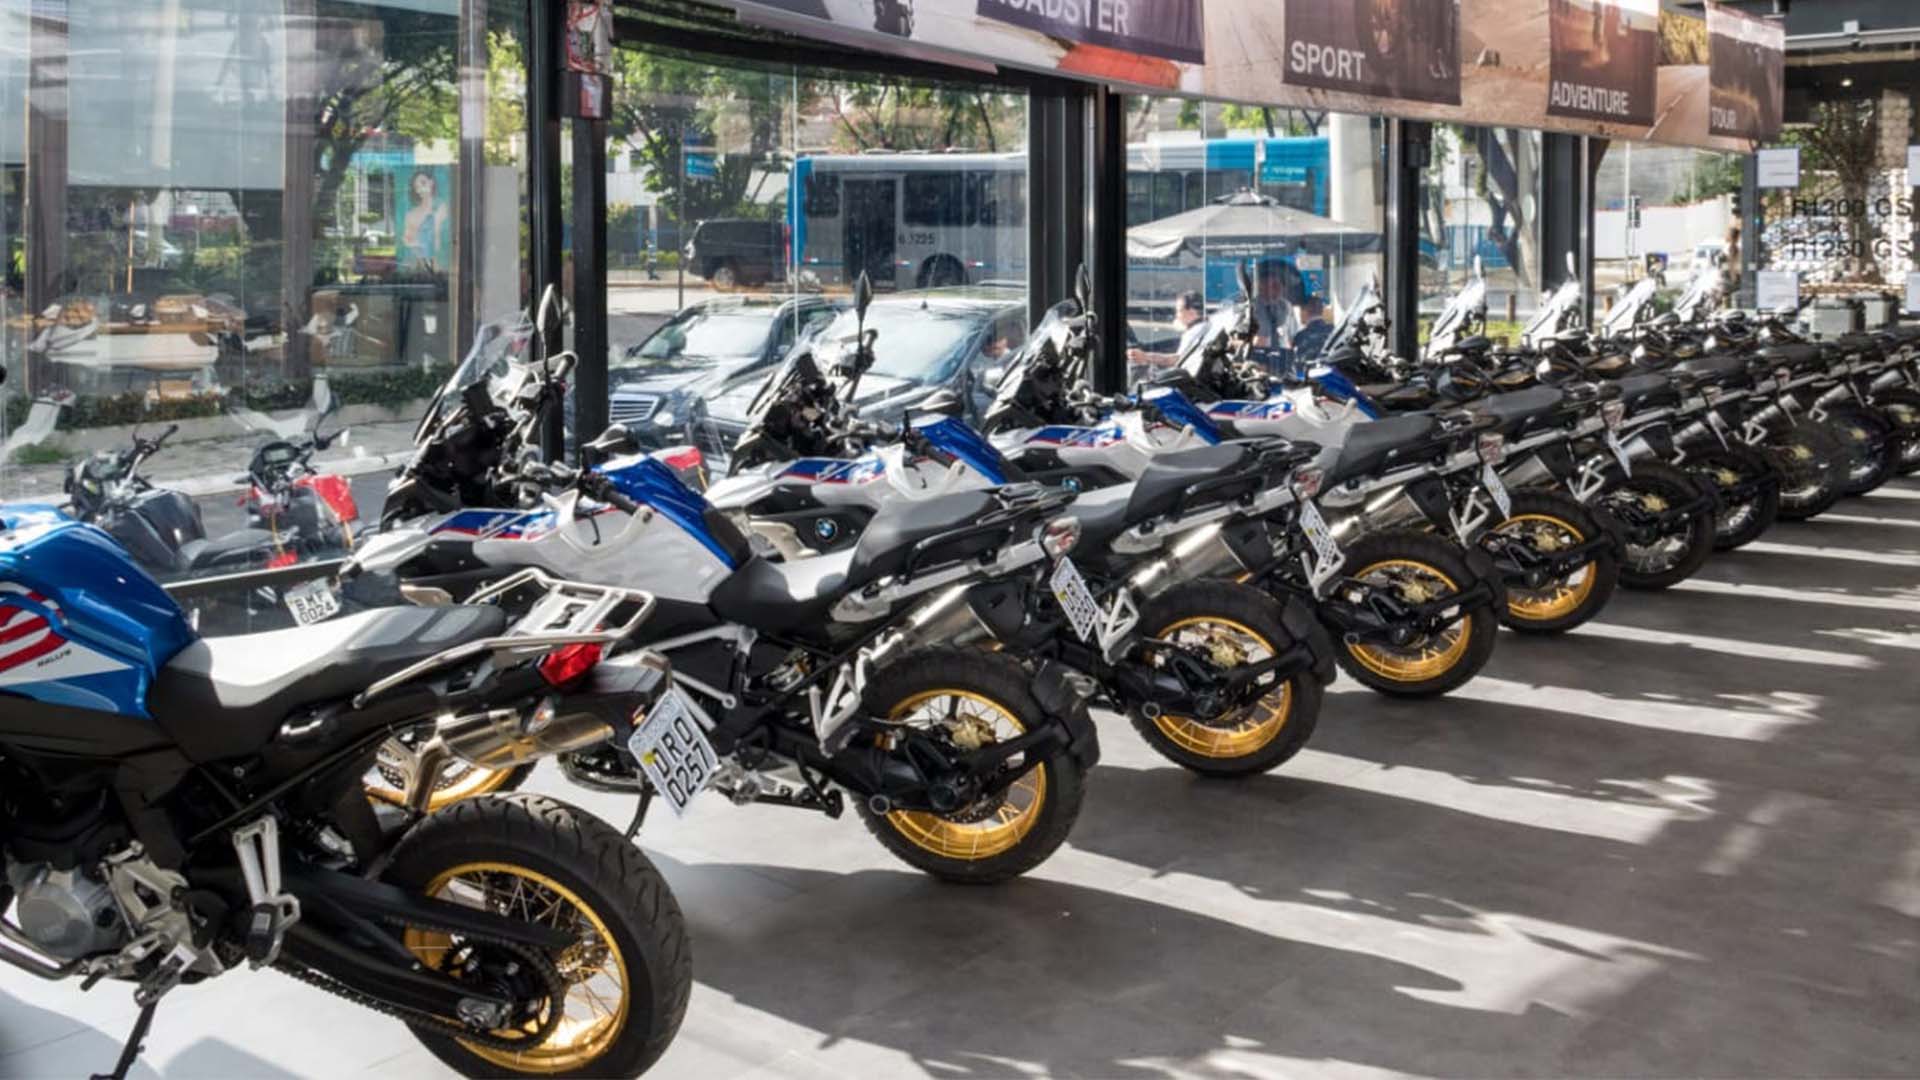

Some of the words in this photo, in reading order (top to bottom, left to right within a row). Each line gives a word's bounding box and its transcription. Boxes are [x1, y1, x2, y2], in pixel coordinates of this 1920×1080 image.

[997, 0, 1129, 35] ADSTER
[1290, 40, 1366, 81] SPORT
[1550, 80, 1630, 115] ADVENTURE
[1712, 106, 1738, 130] TOUR
[1793, 198, 1866, 218] R1200
[1875, 197, 1913, 218] GS
[1792, 238, 1866, 259] R1250
[1874, 238, 1914, 259] GS
[667, 741, 711, 809] 0257
